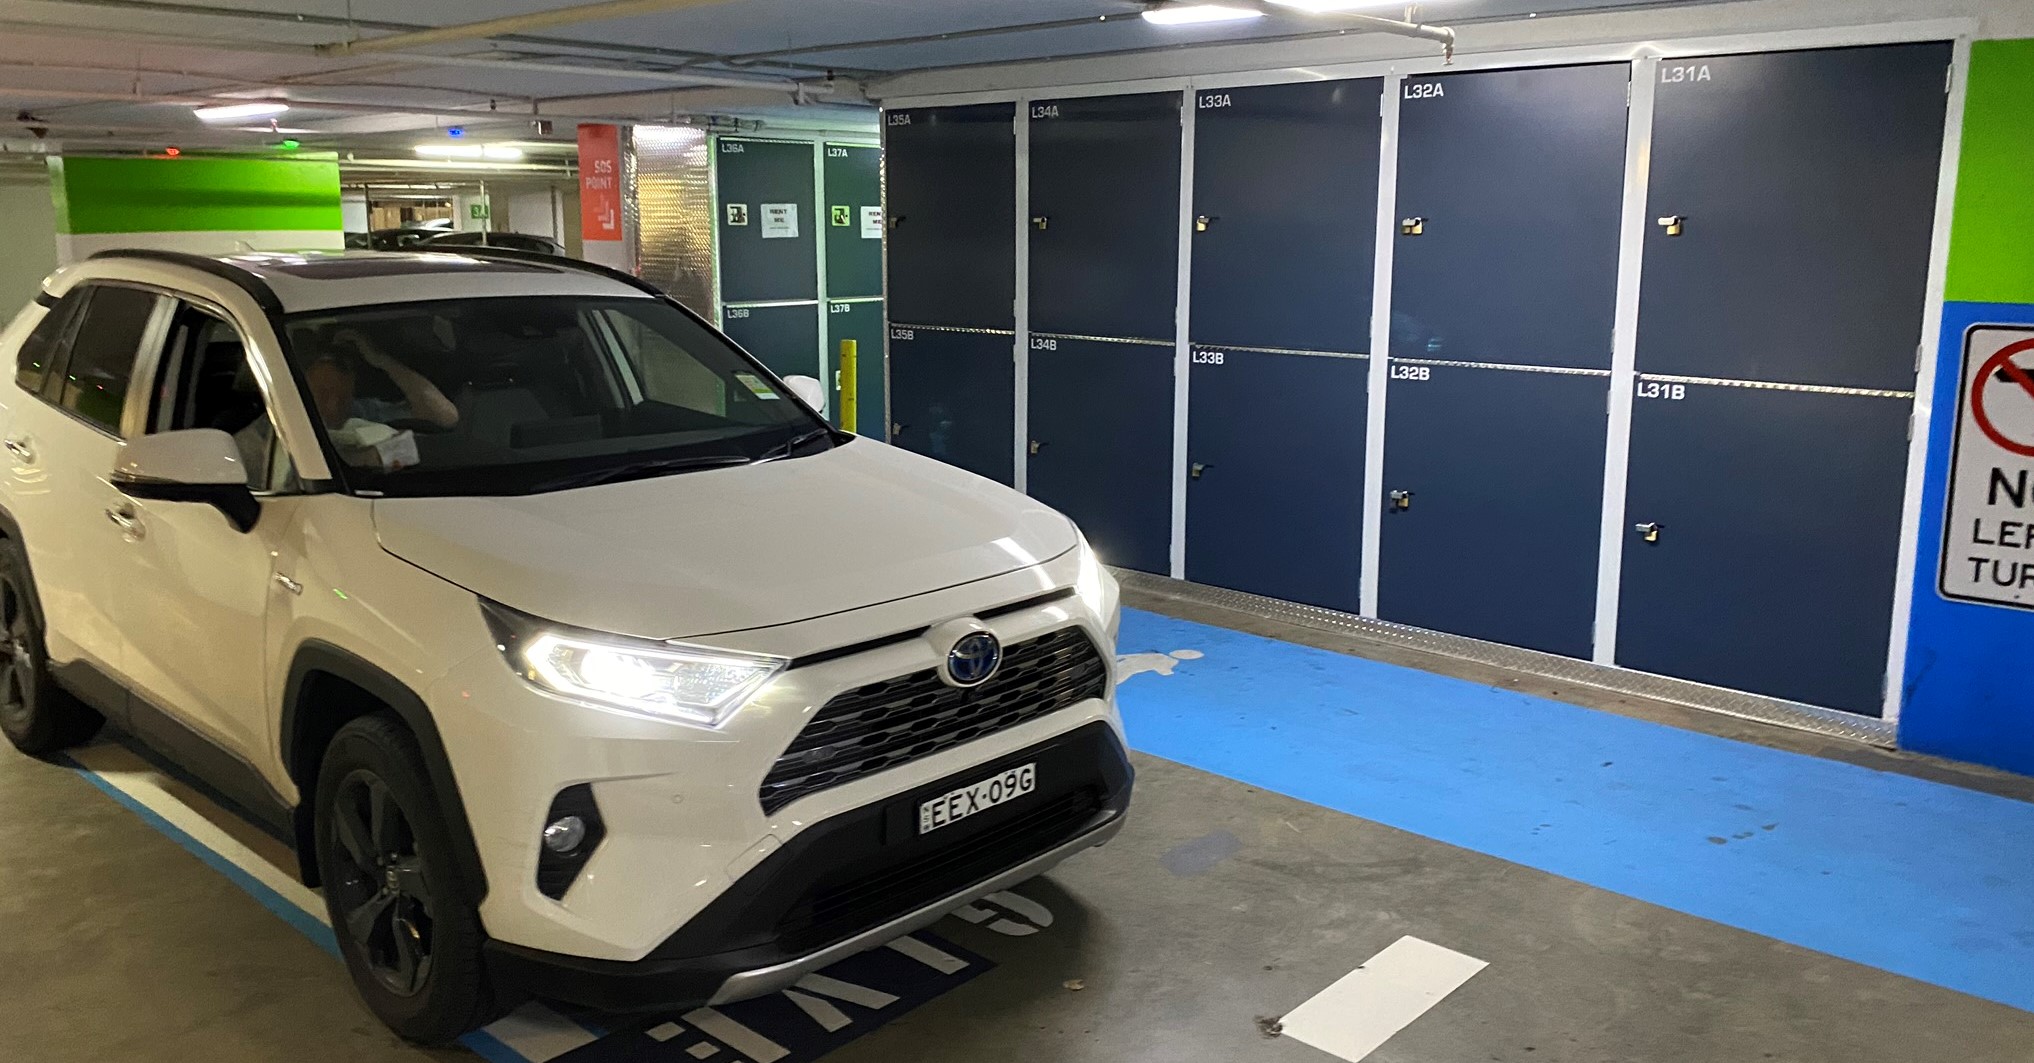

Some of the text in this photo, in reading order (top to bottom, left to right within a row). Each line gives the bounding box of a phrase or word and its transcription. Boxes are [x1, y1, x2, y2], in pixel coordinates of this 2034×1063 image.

[1661, 65, 1711, 83] L31A
[1404, 83, 1444, 99] L32A
[1199, 94, 1231, 108] L33A
[1031, 105, 1059, 118] L34A
[887, 114, 911, 126] L35A
[721, 143, 745, 153] L36A
[827, 148, 848, 157] L37A
[594, 160, 612, 173] SOS
[585, 176, 612, 189] POINT
[727, 309, 749, 318] L36B
[831, 304, 850, 313] L37B
[891, 329, 914, 340] L35B
[1031, 338, 1057, 351] L34B
[1192, 351, 1224, 365] L33B
[1391, 365, 1430, 381] L32B
[1637, 382, 1685, 400] L31B
[1987, 467, 2034, 508] N
